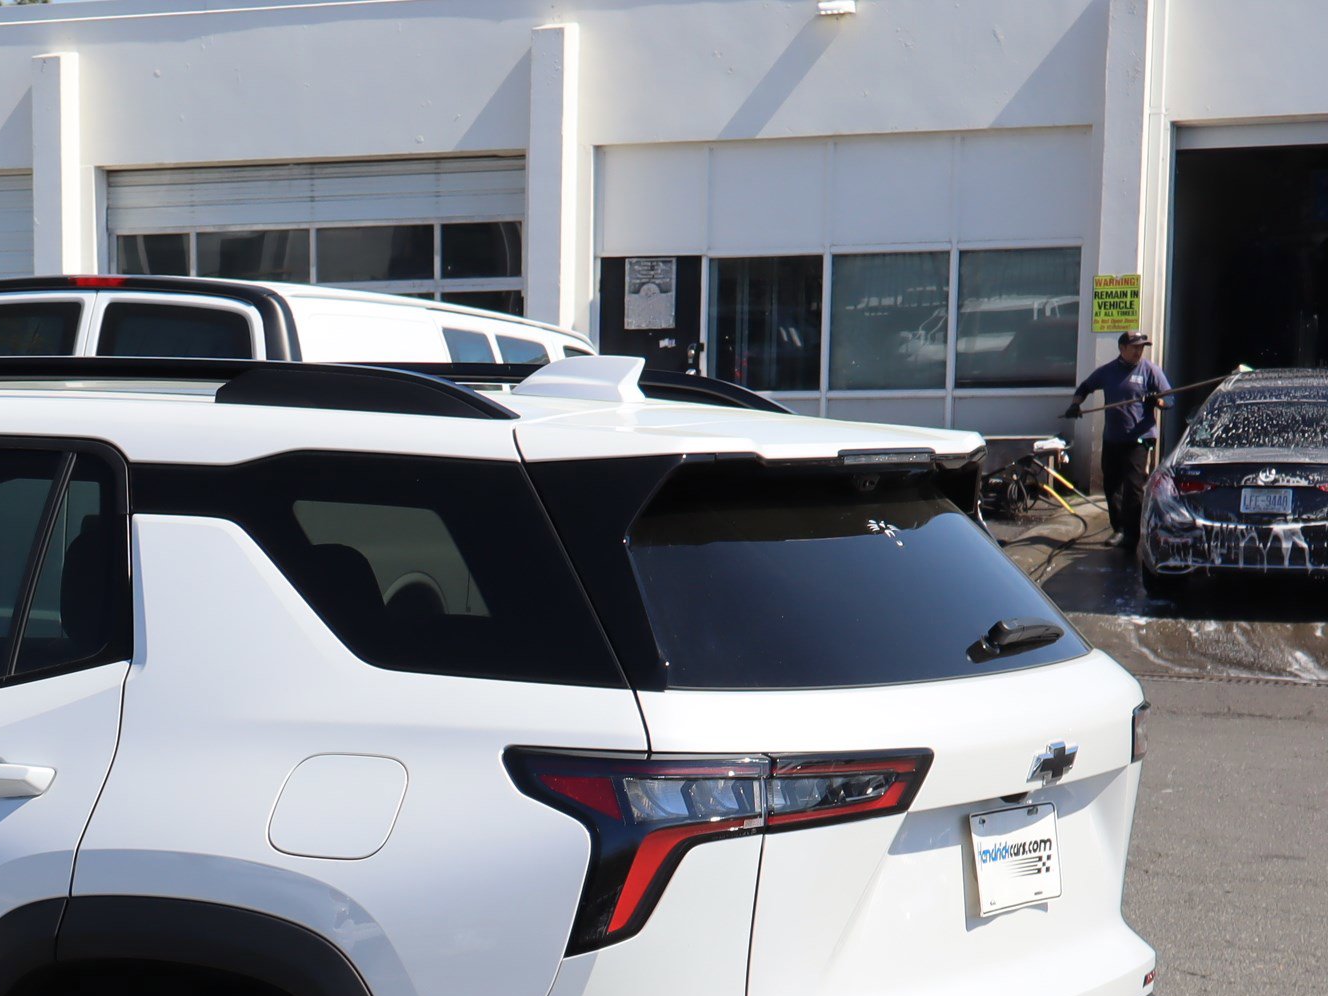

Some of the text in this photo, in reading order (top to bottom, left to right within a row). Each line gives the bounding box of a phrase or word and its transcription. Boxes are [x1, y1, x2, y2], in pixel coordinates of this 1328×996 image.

[1095, 277, 1139, 287] WARNING!
[1094, 290, 1139, 299] REMAIN IN
[1097, 300, 1135, 310] VEHICLE
